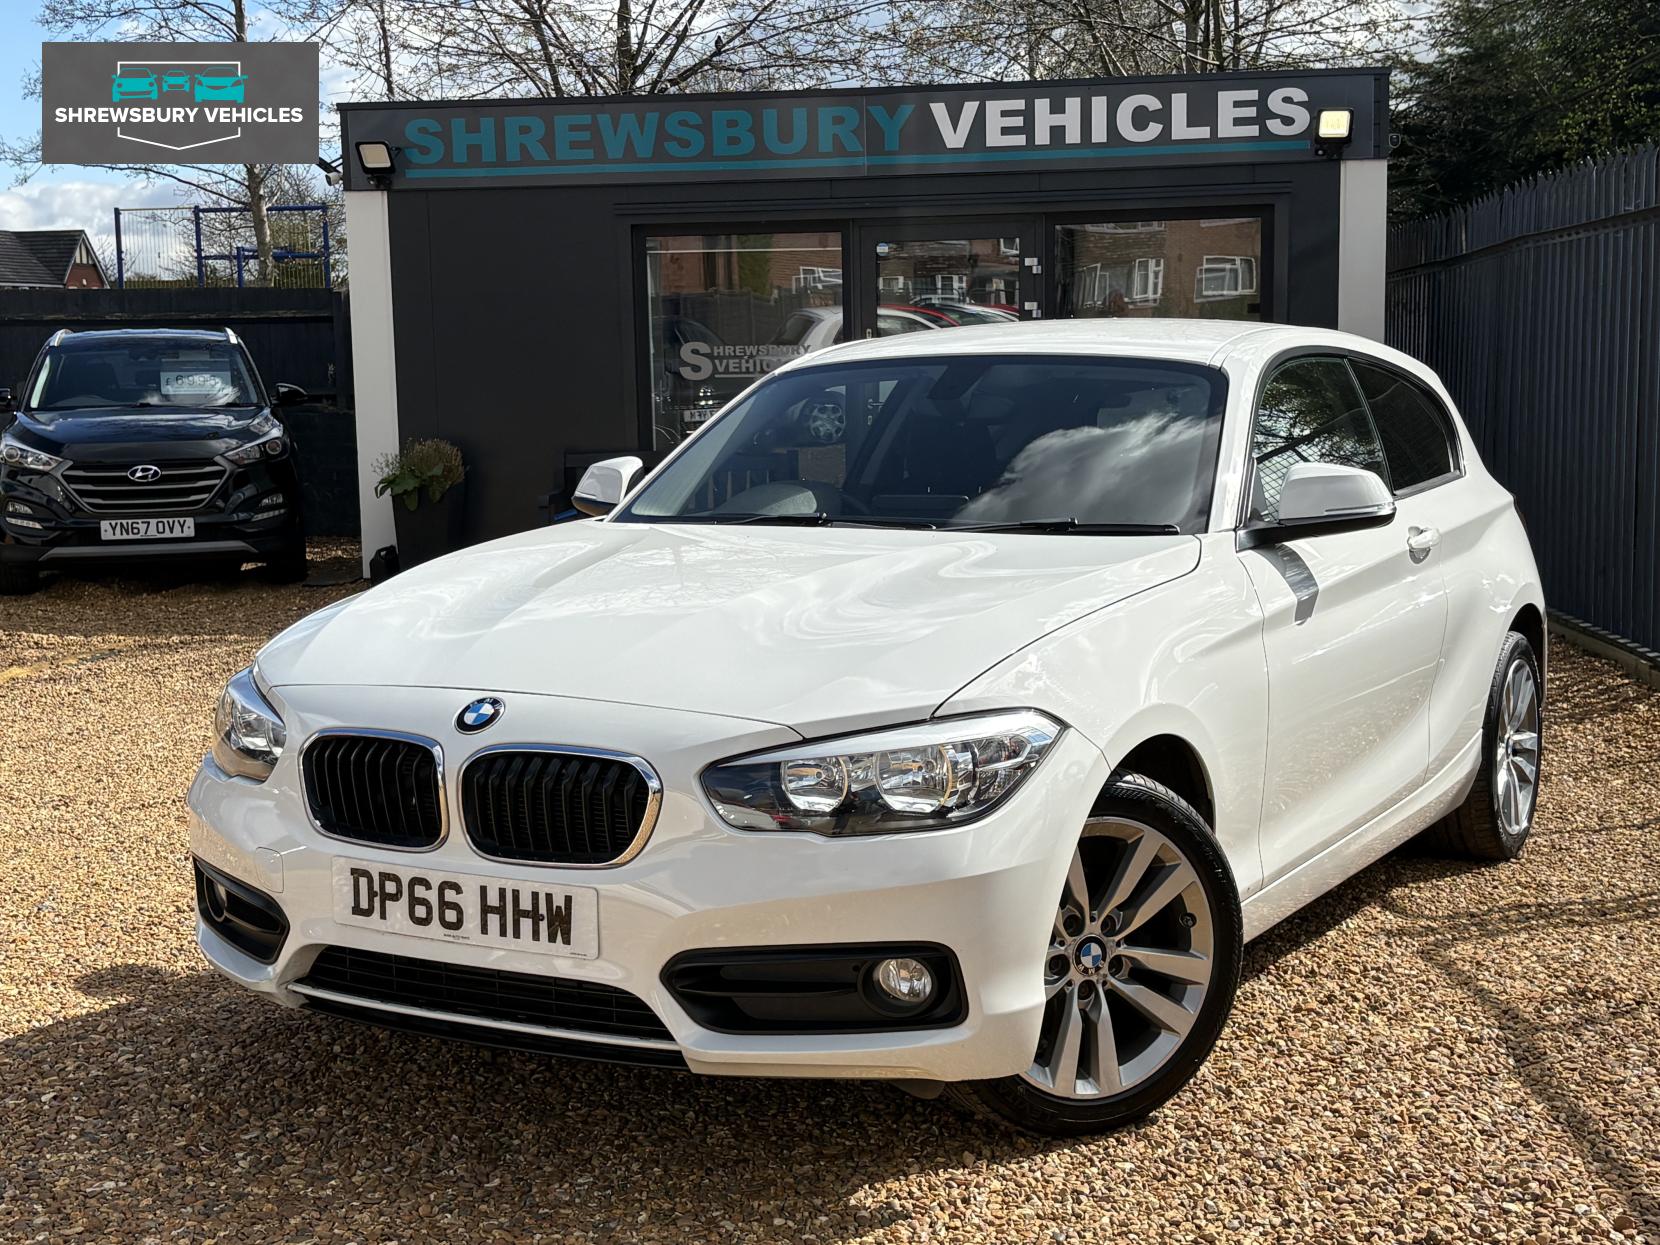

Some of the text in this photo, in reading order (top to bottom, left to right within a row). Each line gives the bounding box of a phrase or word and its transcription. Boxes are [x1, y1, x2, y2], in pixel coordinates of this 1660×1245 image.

[405, 87, 1311, 165] SHREWSBURY VEHICLES
[109, 519, 187, 536] YN67 OVY
[350, 867, 573, 946] DP66 HHW
